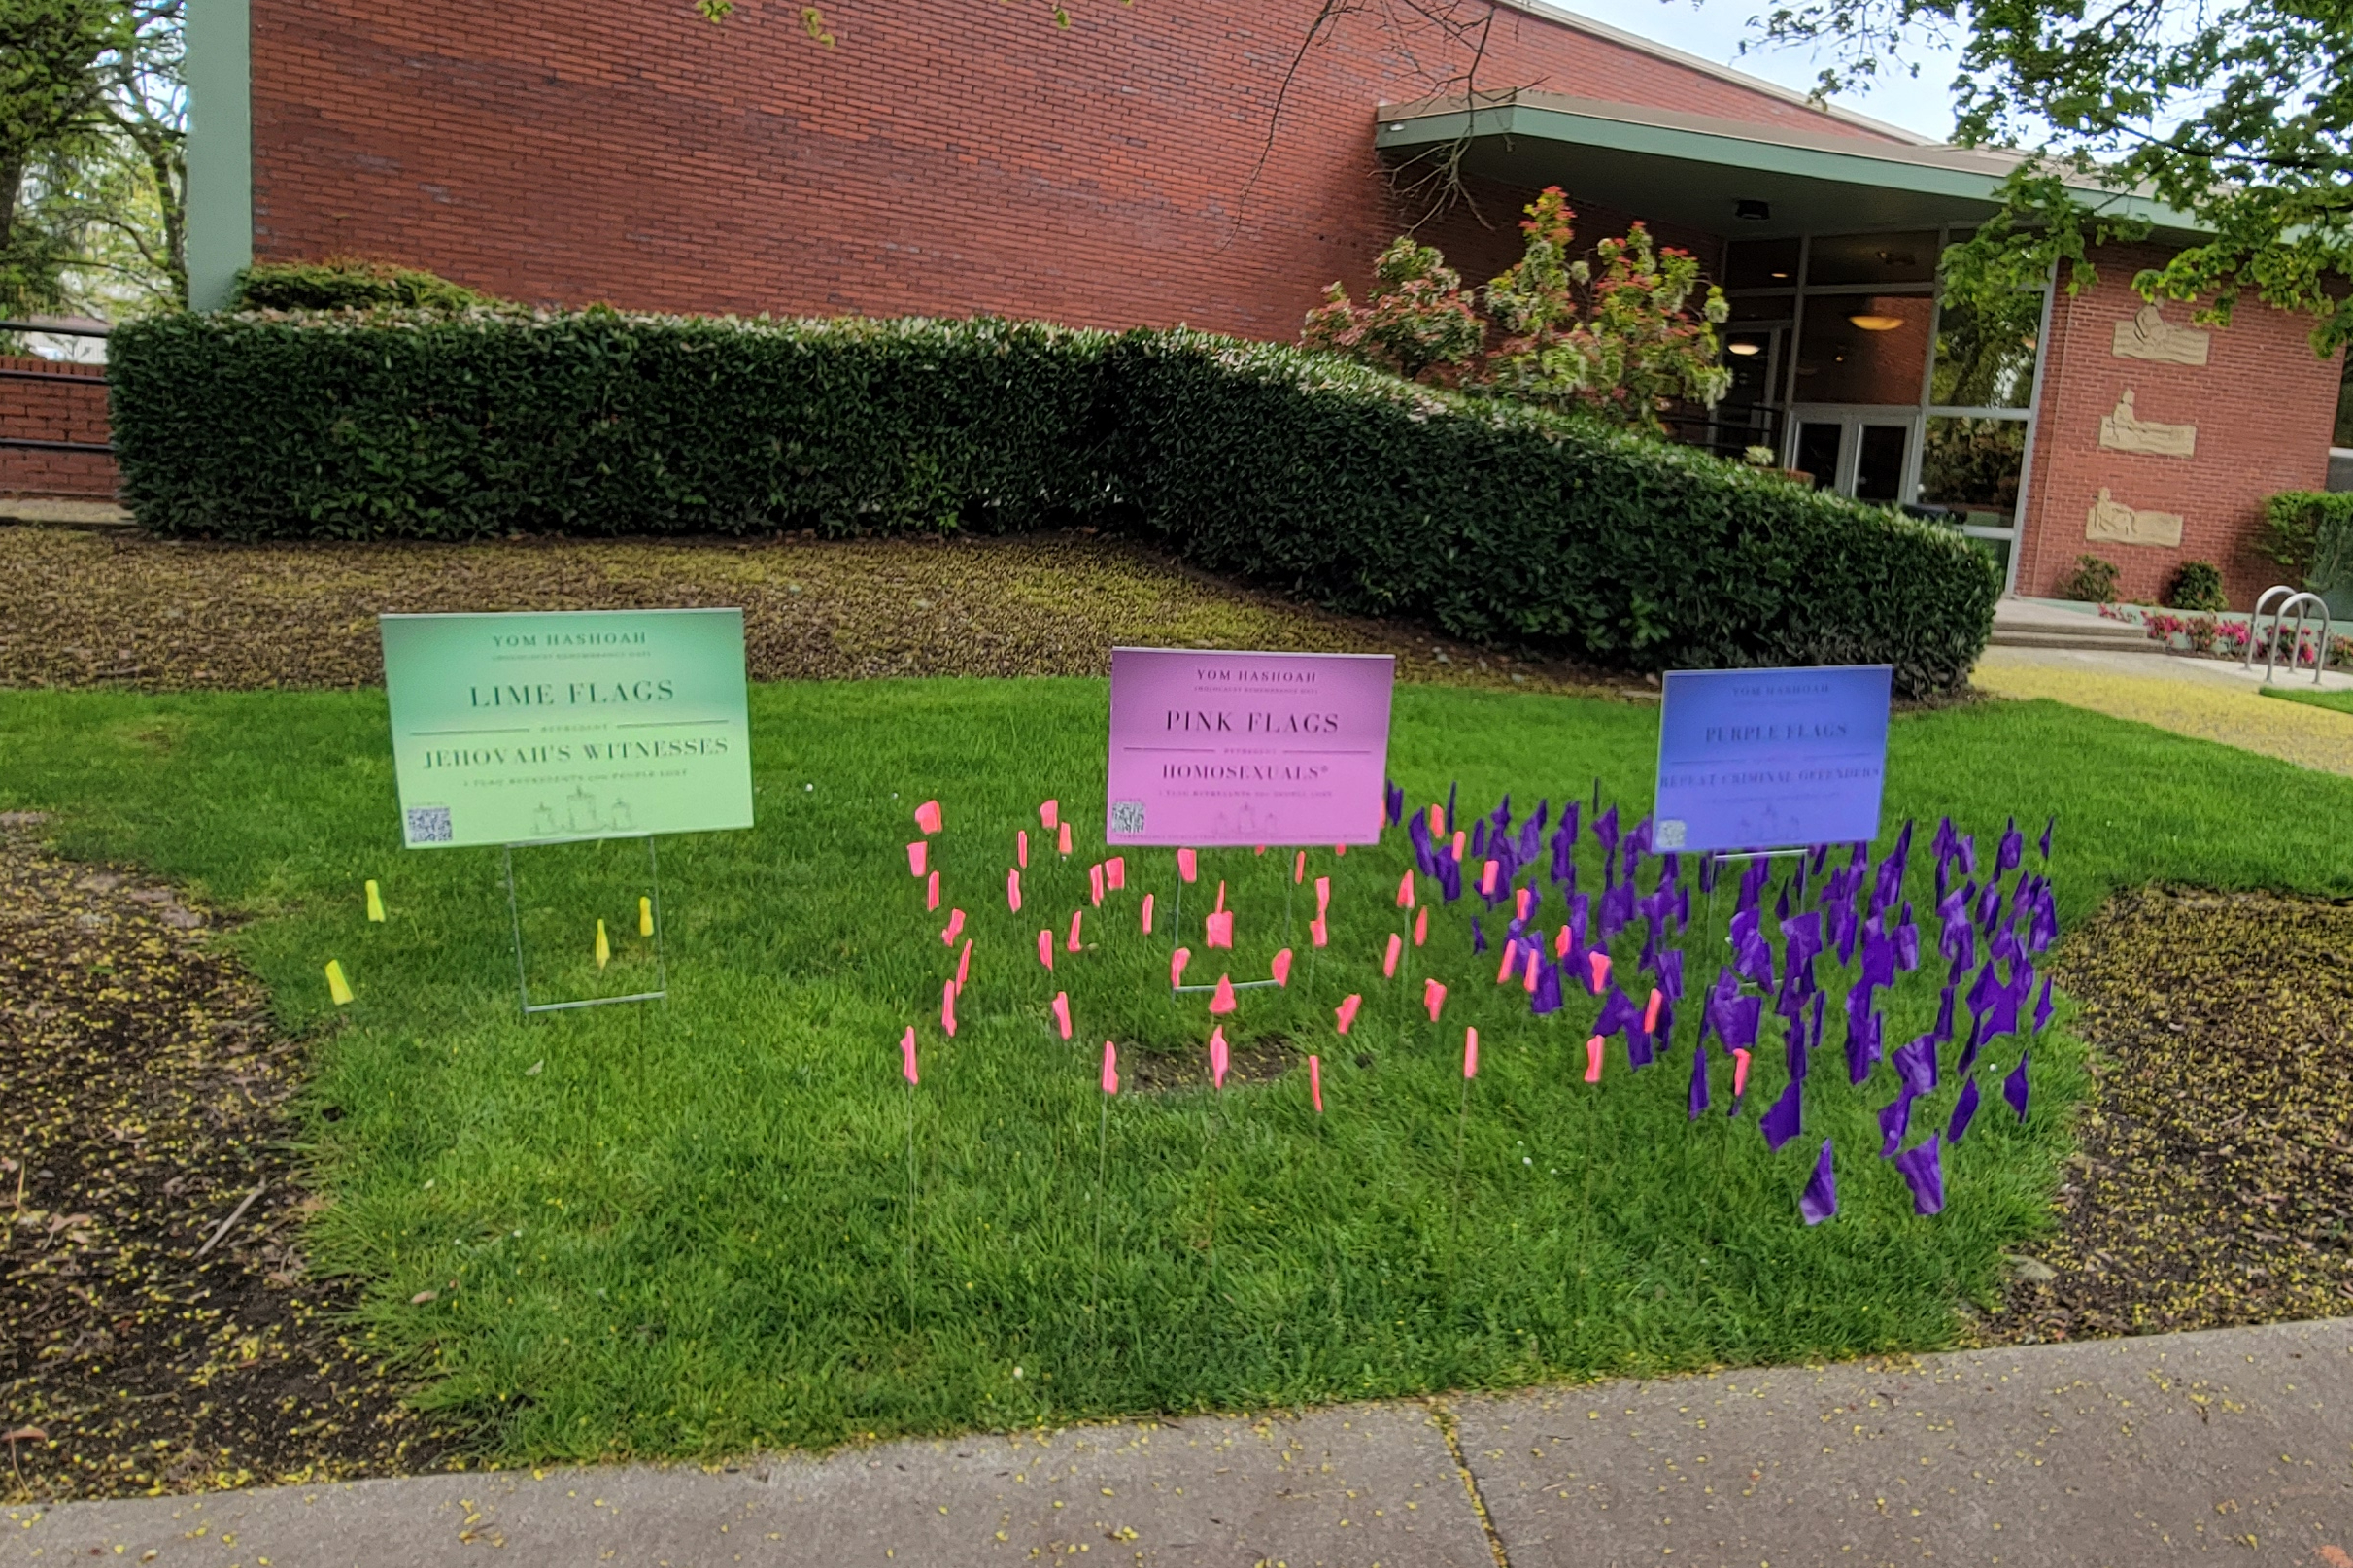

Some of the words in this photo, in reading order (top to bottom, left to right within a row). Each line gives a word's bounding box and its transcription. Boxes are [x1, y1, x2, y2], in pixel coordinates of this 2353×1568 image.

[493, 634, 537, 647] YOM
[546, 631, 646, 646] HASHOAH
[1197, 668, 1231, 681] YOM
[1238, 670, 1316, 683] HASHOAH
[469, 683, 555, 708] LIME
[568, 679, 674, 705] FLAGS
[1165, 709, 1234, 732] PINK
[1247, 712, 1340, 733] FLAGS
[1705, 725, 1778, 743] PURPLE
[1785, 722, 1848, 740] FLAGS
[422, 745, 572, 770] JEHOVAH'S
[582, 737, 730, 762] WITNESSES
